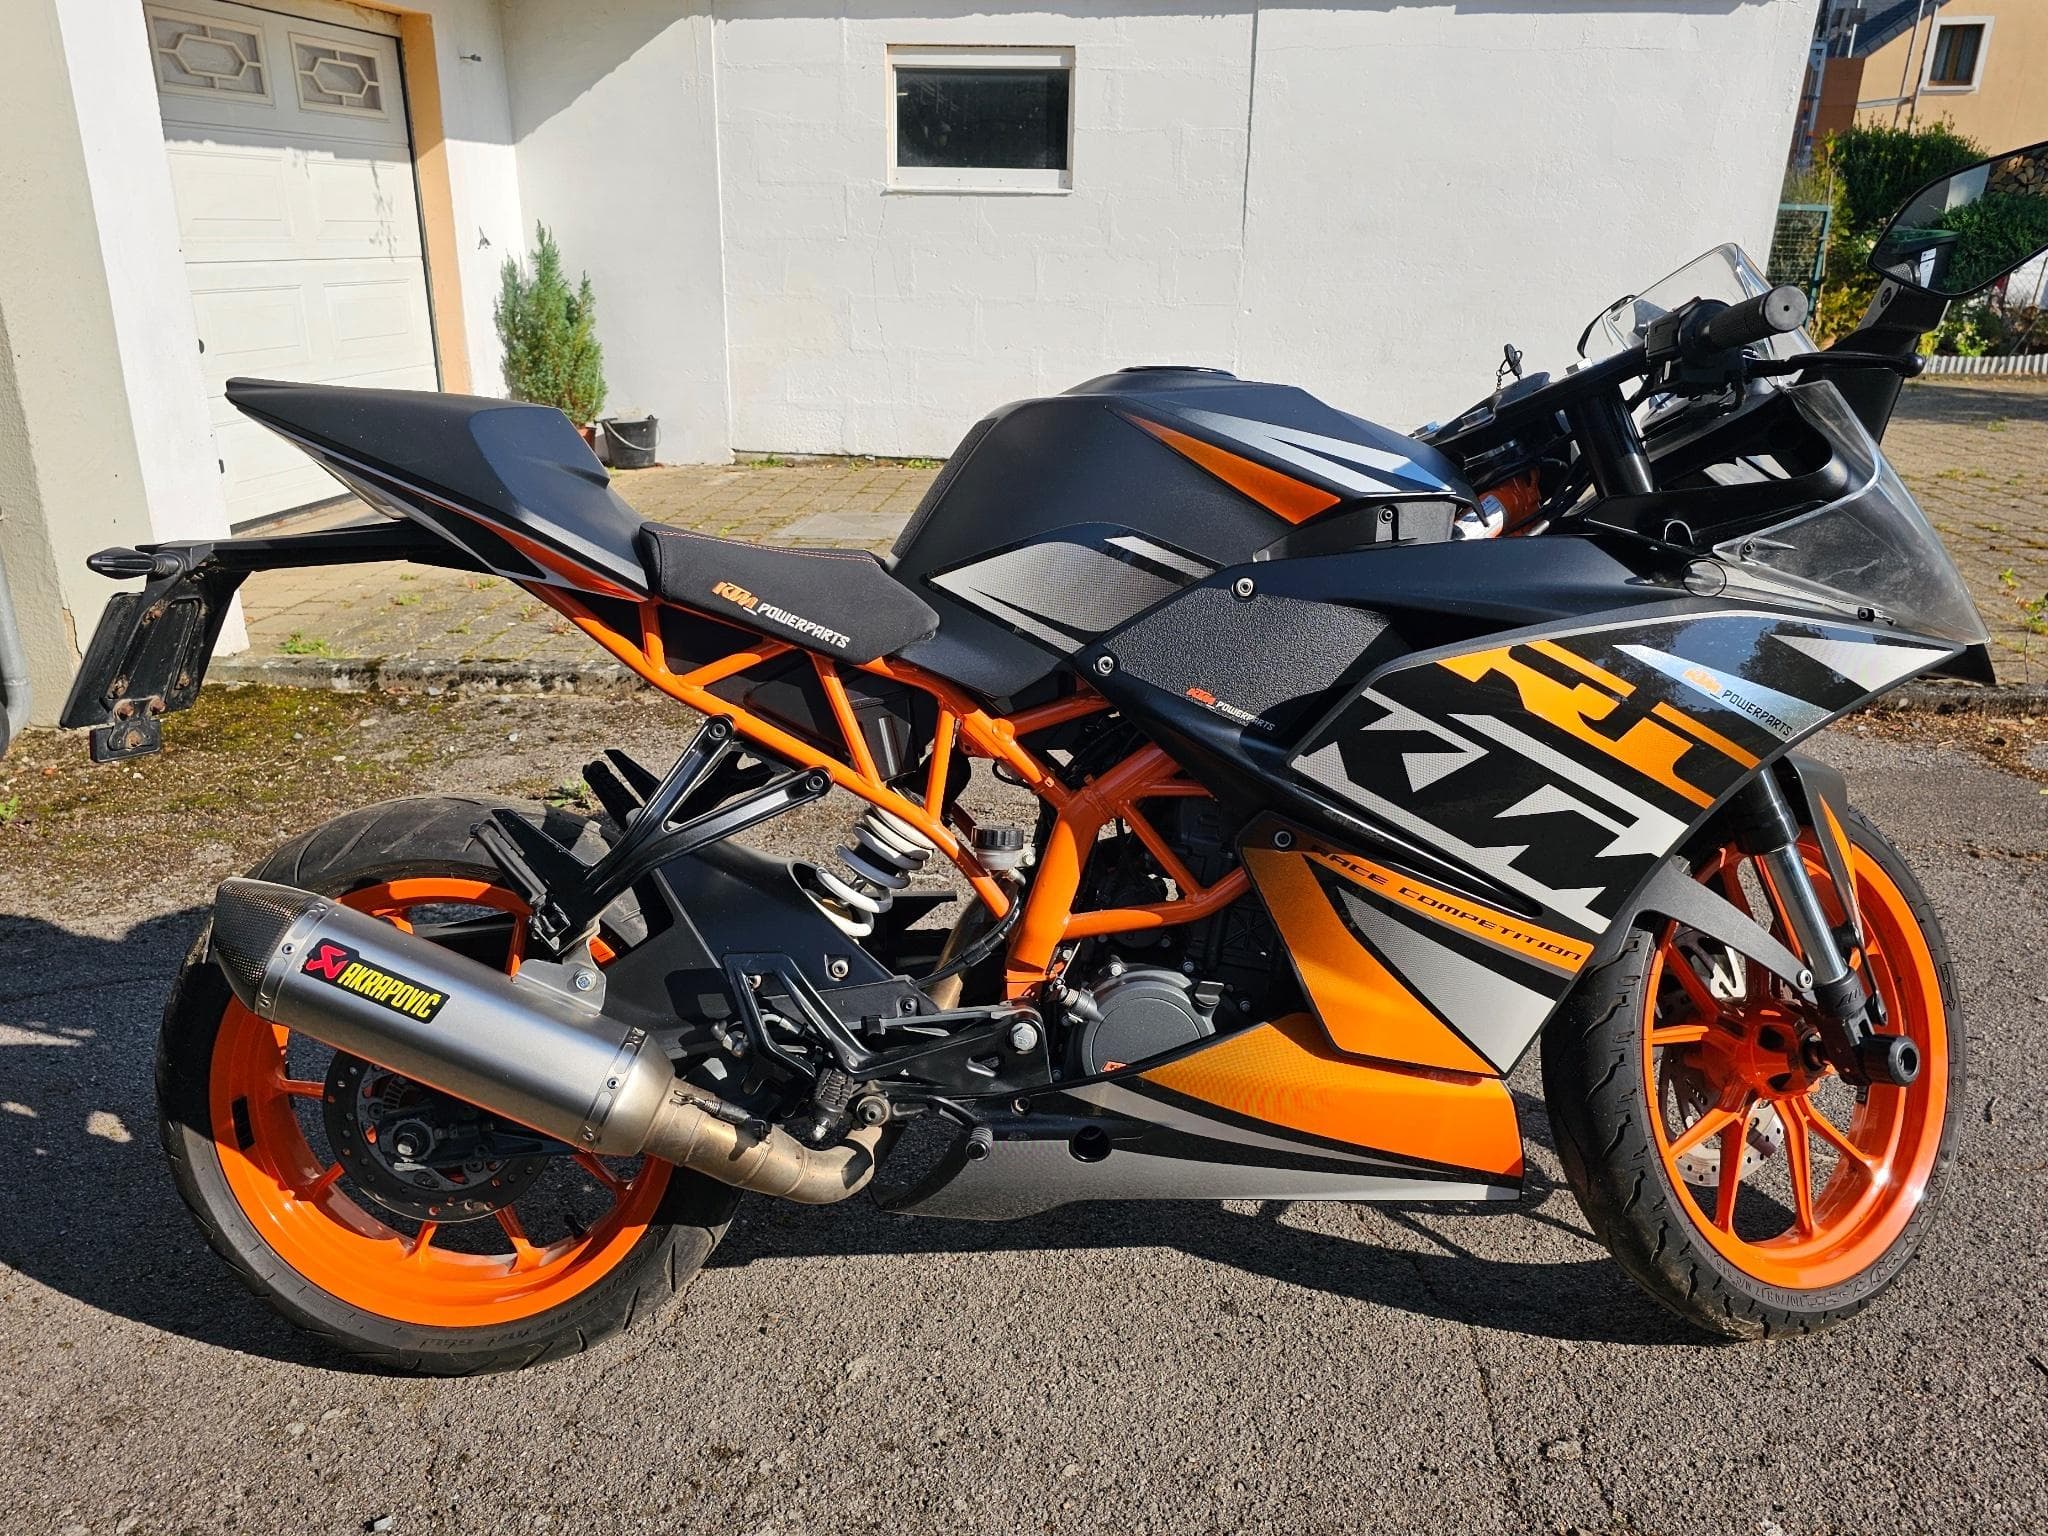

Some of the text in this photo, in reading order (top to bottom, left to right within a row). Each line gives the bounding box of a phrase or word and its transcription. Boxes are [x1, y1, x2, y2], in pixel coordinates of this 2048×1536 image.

[711, 580, 850, 649] KTM POWERPARTS
[1215, 700, 1276, 732] POWERPARTS
[1721, 689, 1793, 737] POWERPARTS
[1290, 687, 1690, 935] KTM
[1310, 844, 1582, 963] RACE COMPETITION
